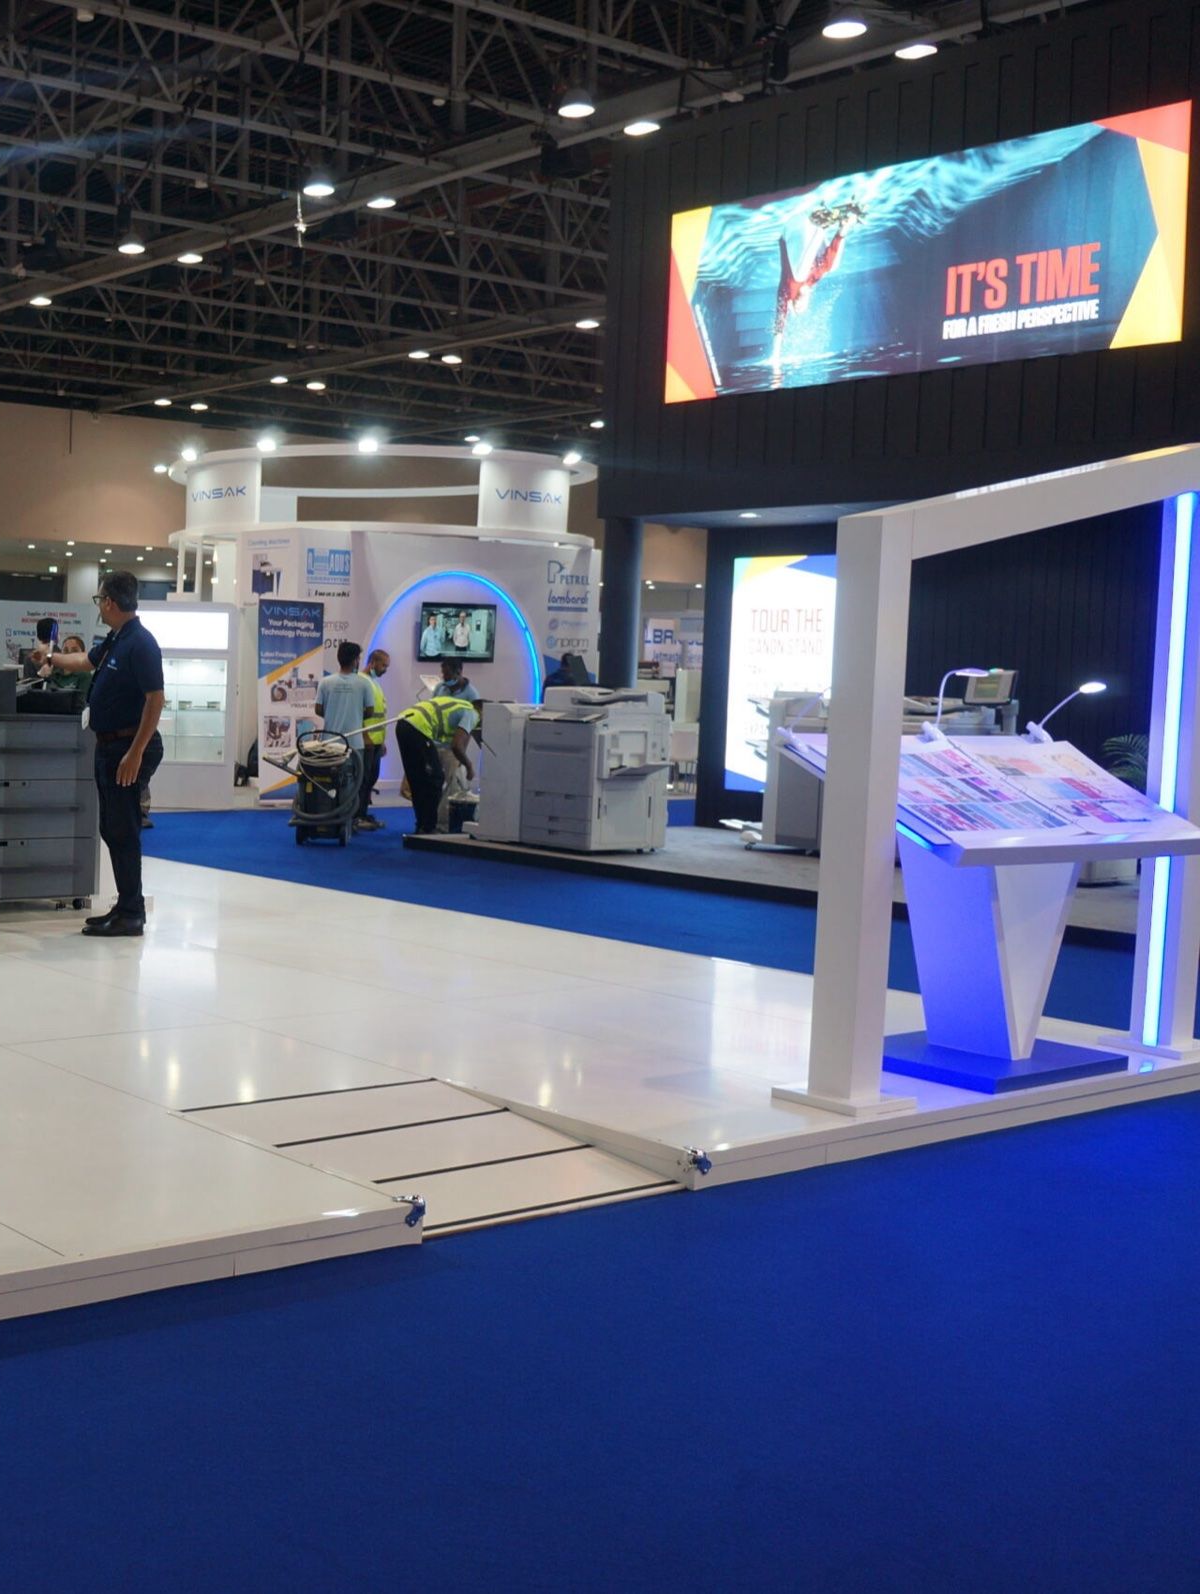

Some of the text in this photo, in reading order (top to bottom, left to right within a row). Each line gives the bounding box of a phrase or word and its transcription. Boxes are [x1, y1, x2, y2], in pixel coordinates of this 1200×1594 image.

[945, 241, 1101, 316] IT'S TIME
[942, 299, 1100, 340] FOR A FRESH PERSPECTIVE
[192, 486, 247, 502] VINSAK
[495, 488, 562, 504] VINSAK
[262, 605, 320, 617] VINSAK
[751, 608, 824, 633] TOUR THE
